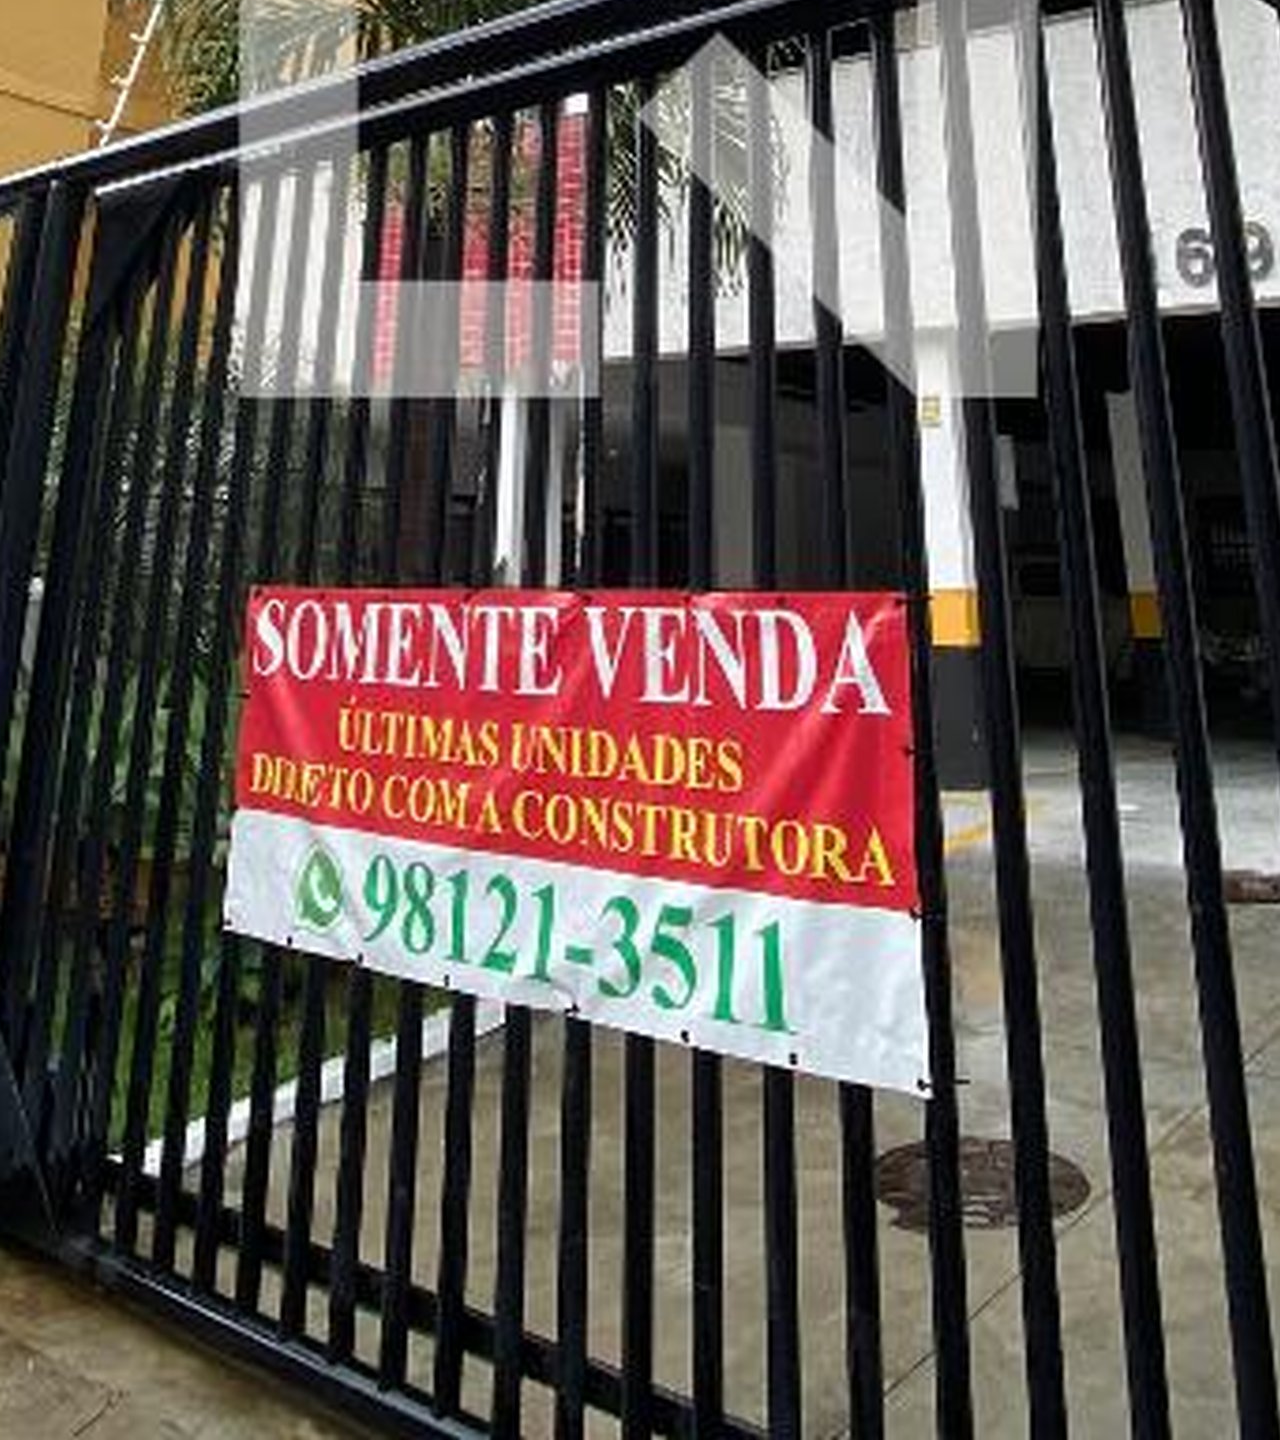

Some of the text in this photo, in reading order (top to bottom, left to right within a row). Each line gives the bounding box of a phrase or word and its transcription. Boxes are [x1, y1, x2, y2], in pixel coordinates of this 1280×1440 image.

[253, 598, 893, 717] SOMENTE VENDA
[337, 695, 745, 793] ÚLTIMAS UNIDADES
[382, 772, 470, 830] COM
[477, 788, 503, 835] A
[512, 789, 897, 888] CONSTRUTORA
[361, 853, 798, 1037] 98121-3511
